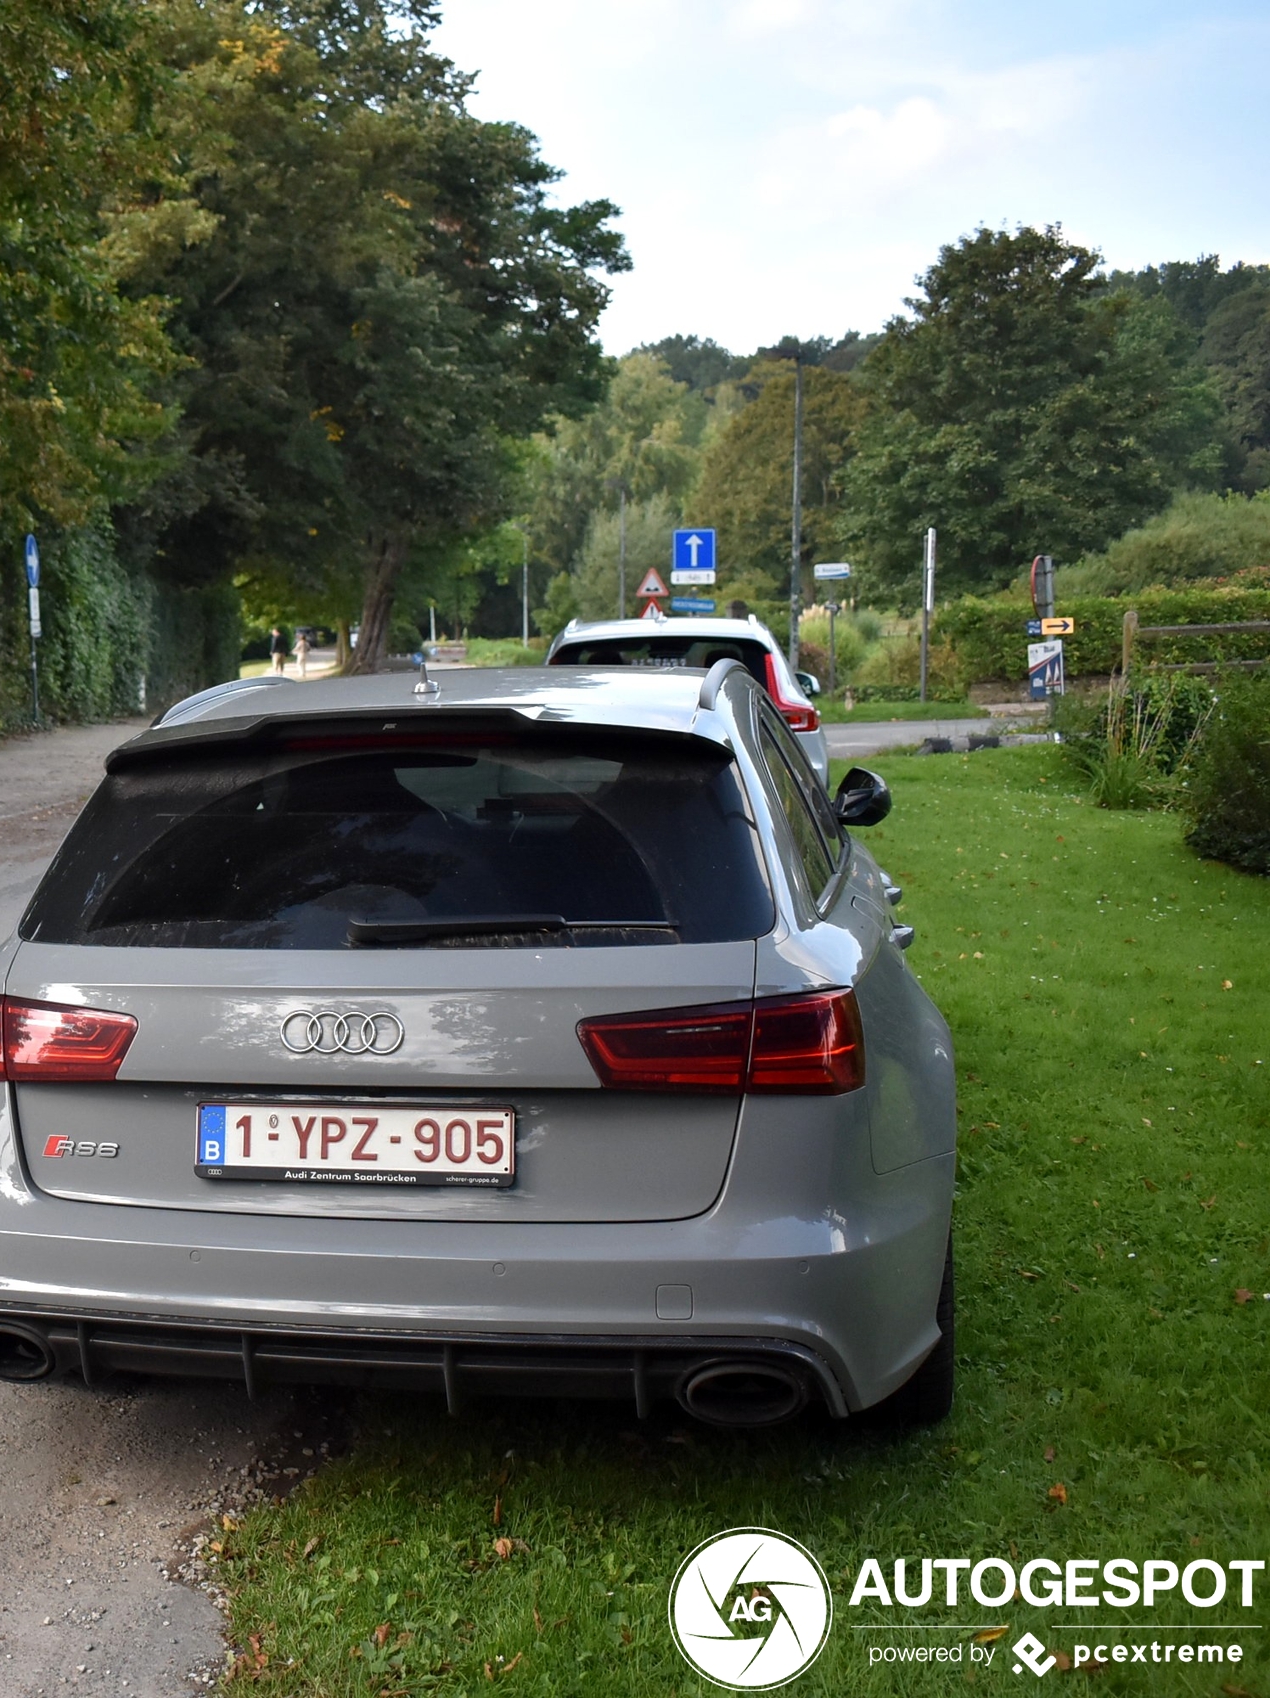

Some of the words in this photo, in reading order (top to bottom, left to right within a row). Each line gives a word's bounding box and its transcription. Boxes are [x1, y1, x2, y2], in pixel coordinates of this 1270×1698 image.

[55, 1140, 119, 1158] RS6
[205, 1140, 220, 1160] B
[284, 1170, 308, 1179] Audi
[310, 1171, 352, 1181] Zentrum
[354, 1173, 417, 1183] Saarbrücken
[445, 1175, 499, 1184] scherer-gruppe.de
